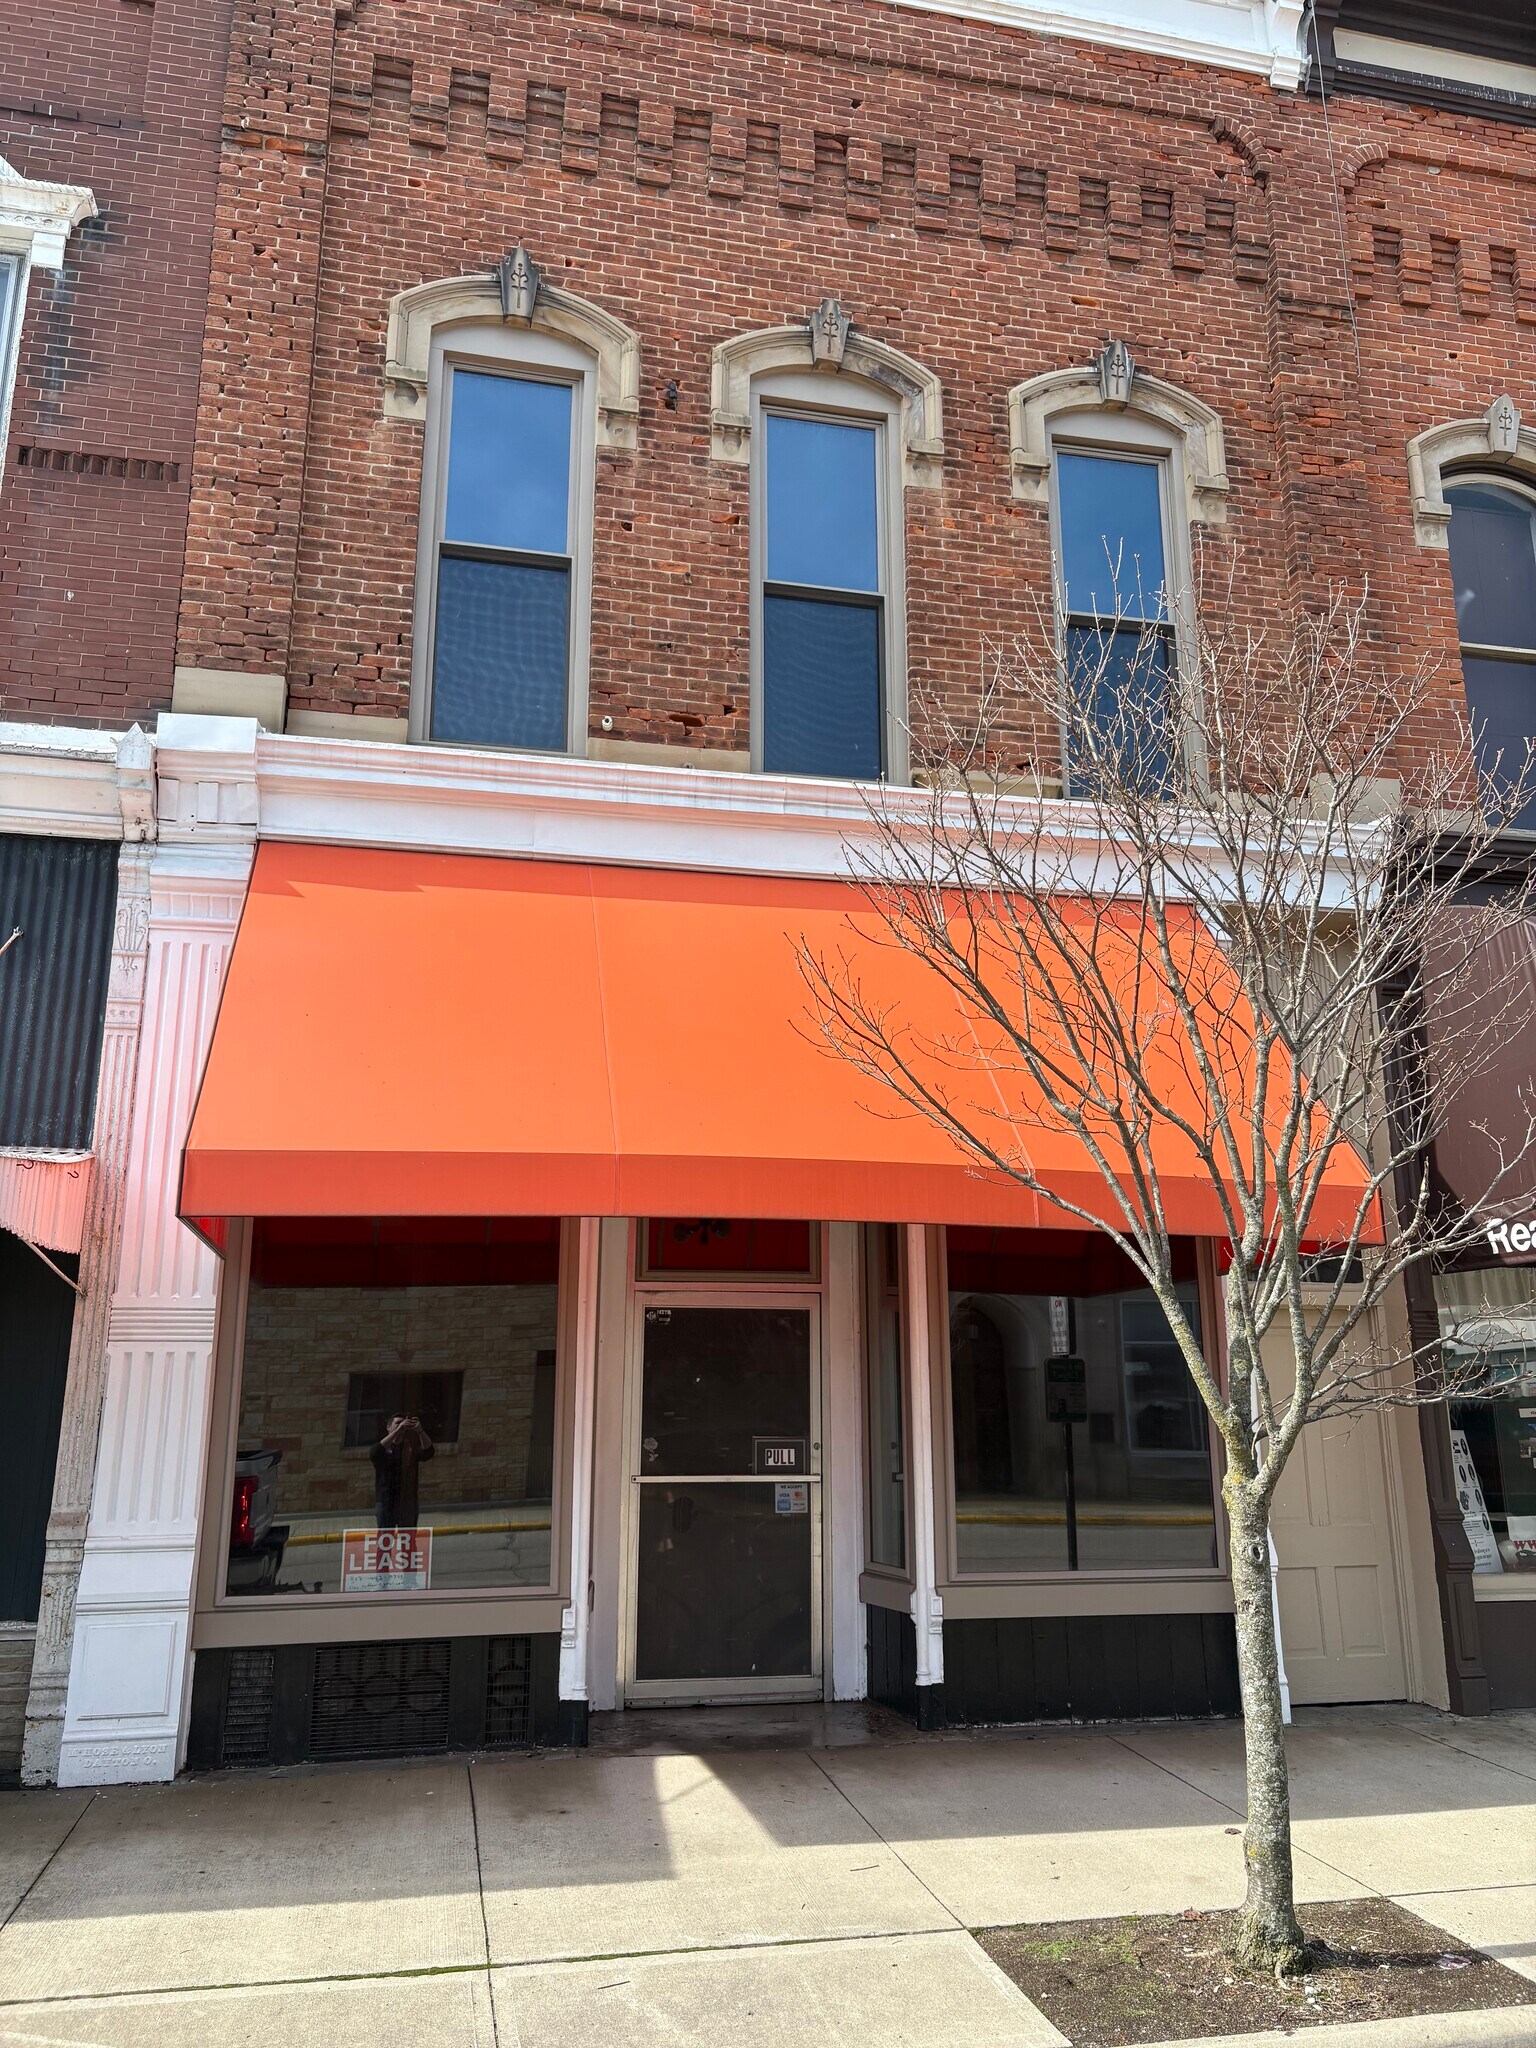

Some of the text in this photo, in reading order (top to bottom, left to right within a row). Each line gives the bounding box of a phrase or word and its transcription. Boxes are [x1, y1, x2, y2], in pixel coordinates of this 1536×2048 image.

[766, 1449, 794, 1465] PULL
[364, 1532, 411, 1552] FOR
[349, 1551, 424, 1571] LEASE
[122, 1745, 132, 1756] &
[132, 1743, 167, 1755] LYON
[83, 1757, 140, 1769] DAYTON
